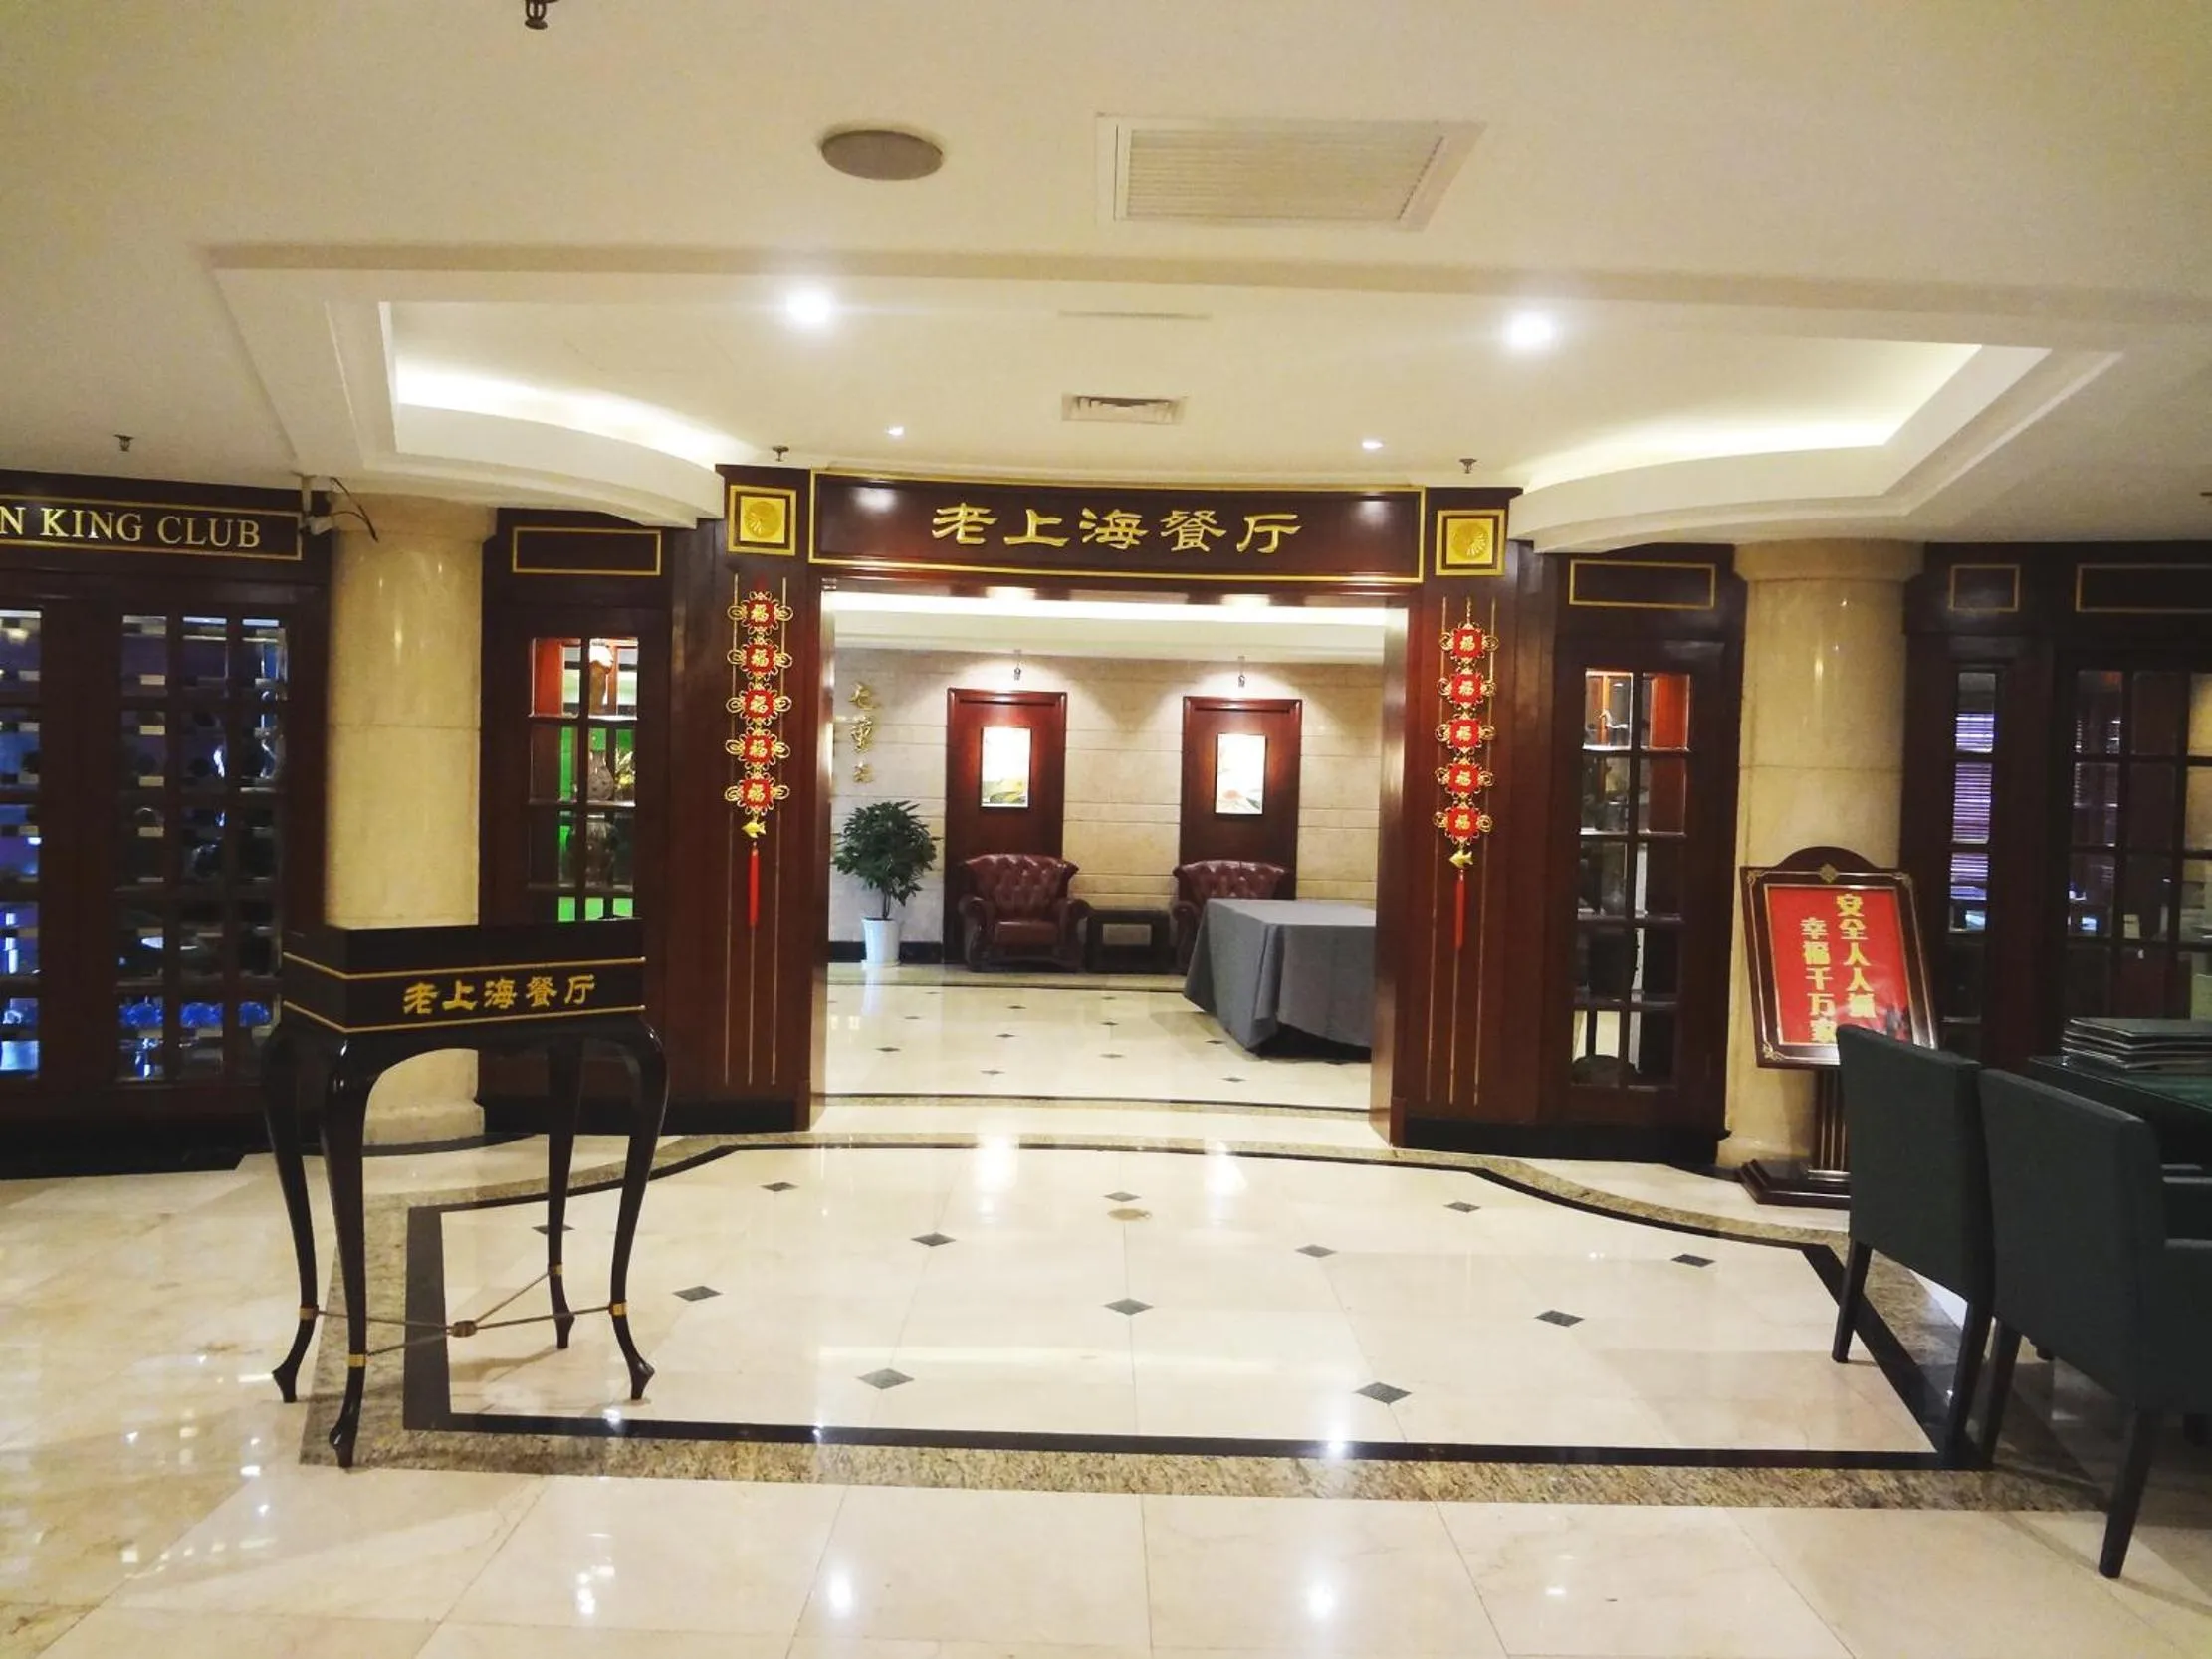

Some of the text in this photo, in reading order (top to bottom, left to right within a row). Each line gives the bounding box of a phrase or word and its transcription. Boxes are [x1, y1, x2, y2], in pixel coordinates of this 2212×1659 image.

[0, 506, 261, 549] N KING CLUB
[931, 502, 1303, 554] 老上海餐厅
[402, 974, 596, 1015] 老上海餐厅
